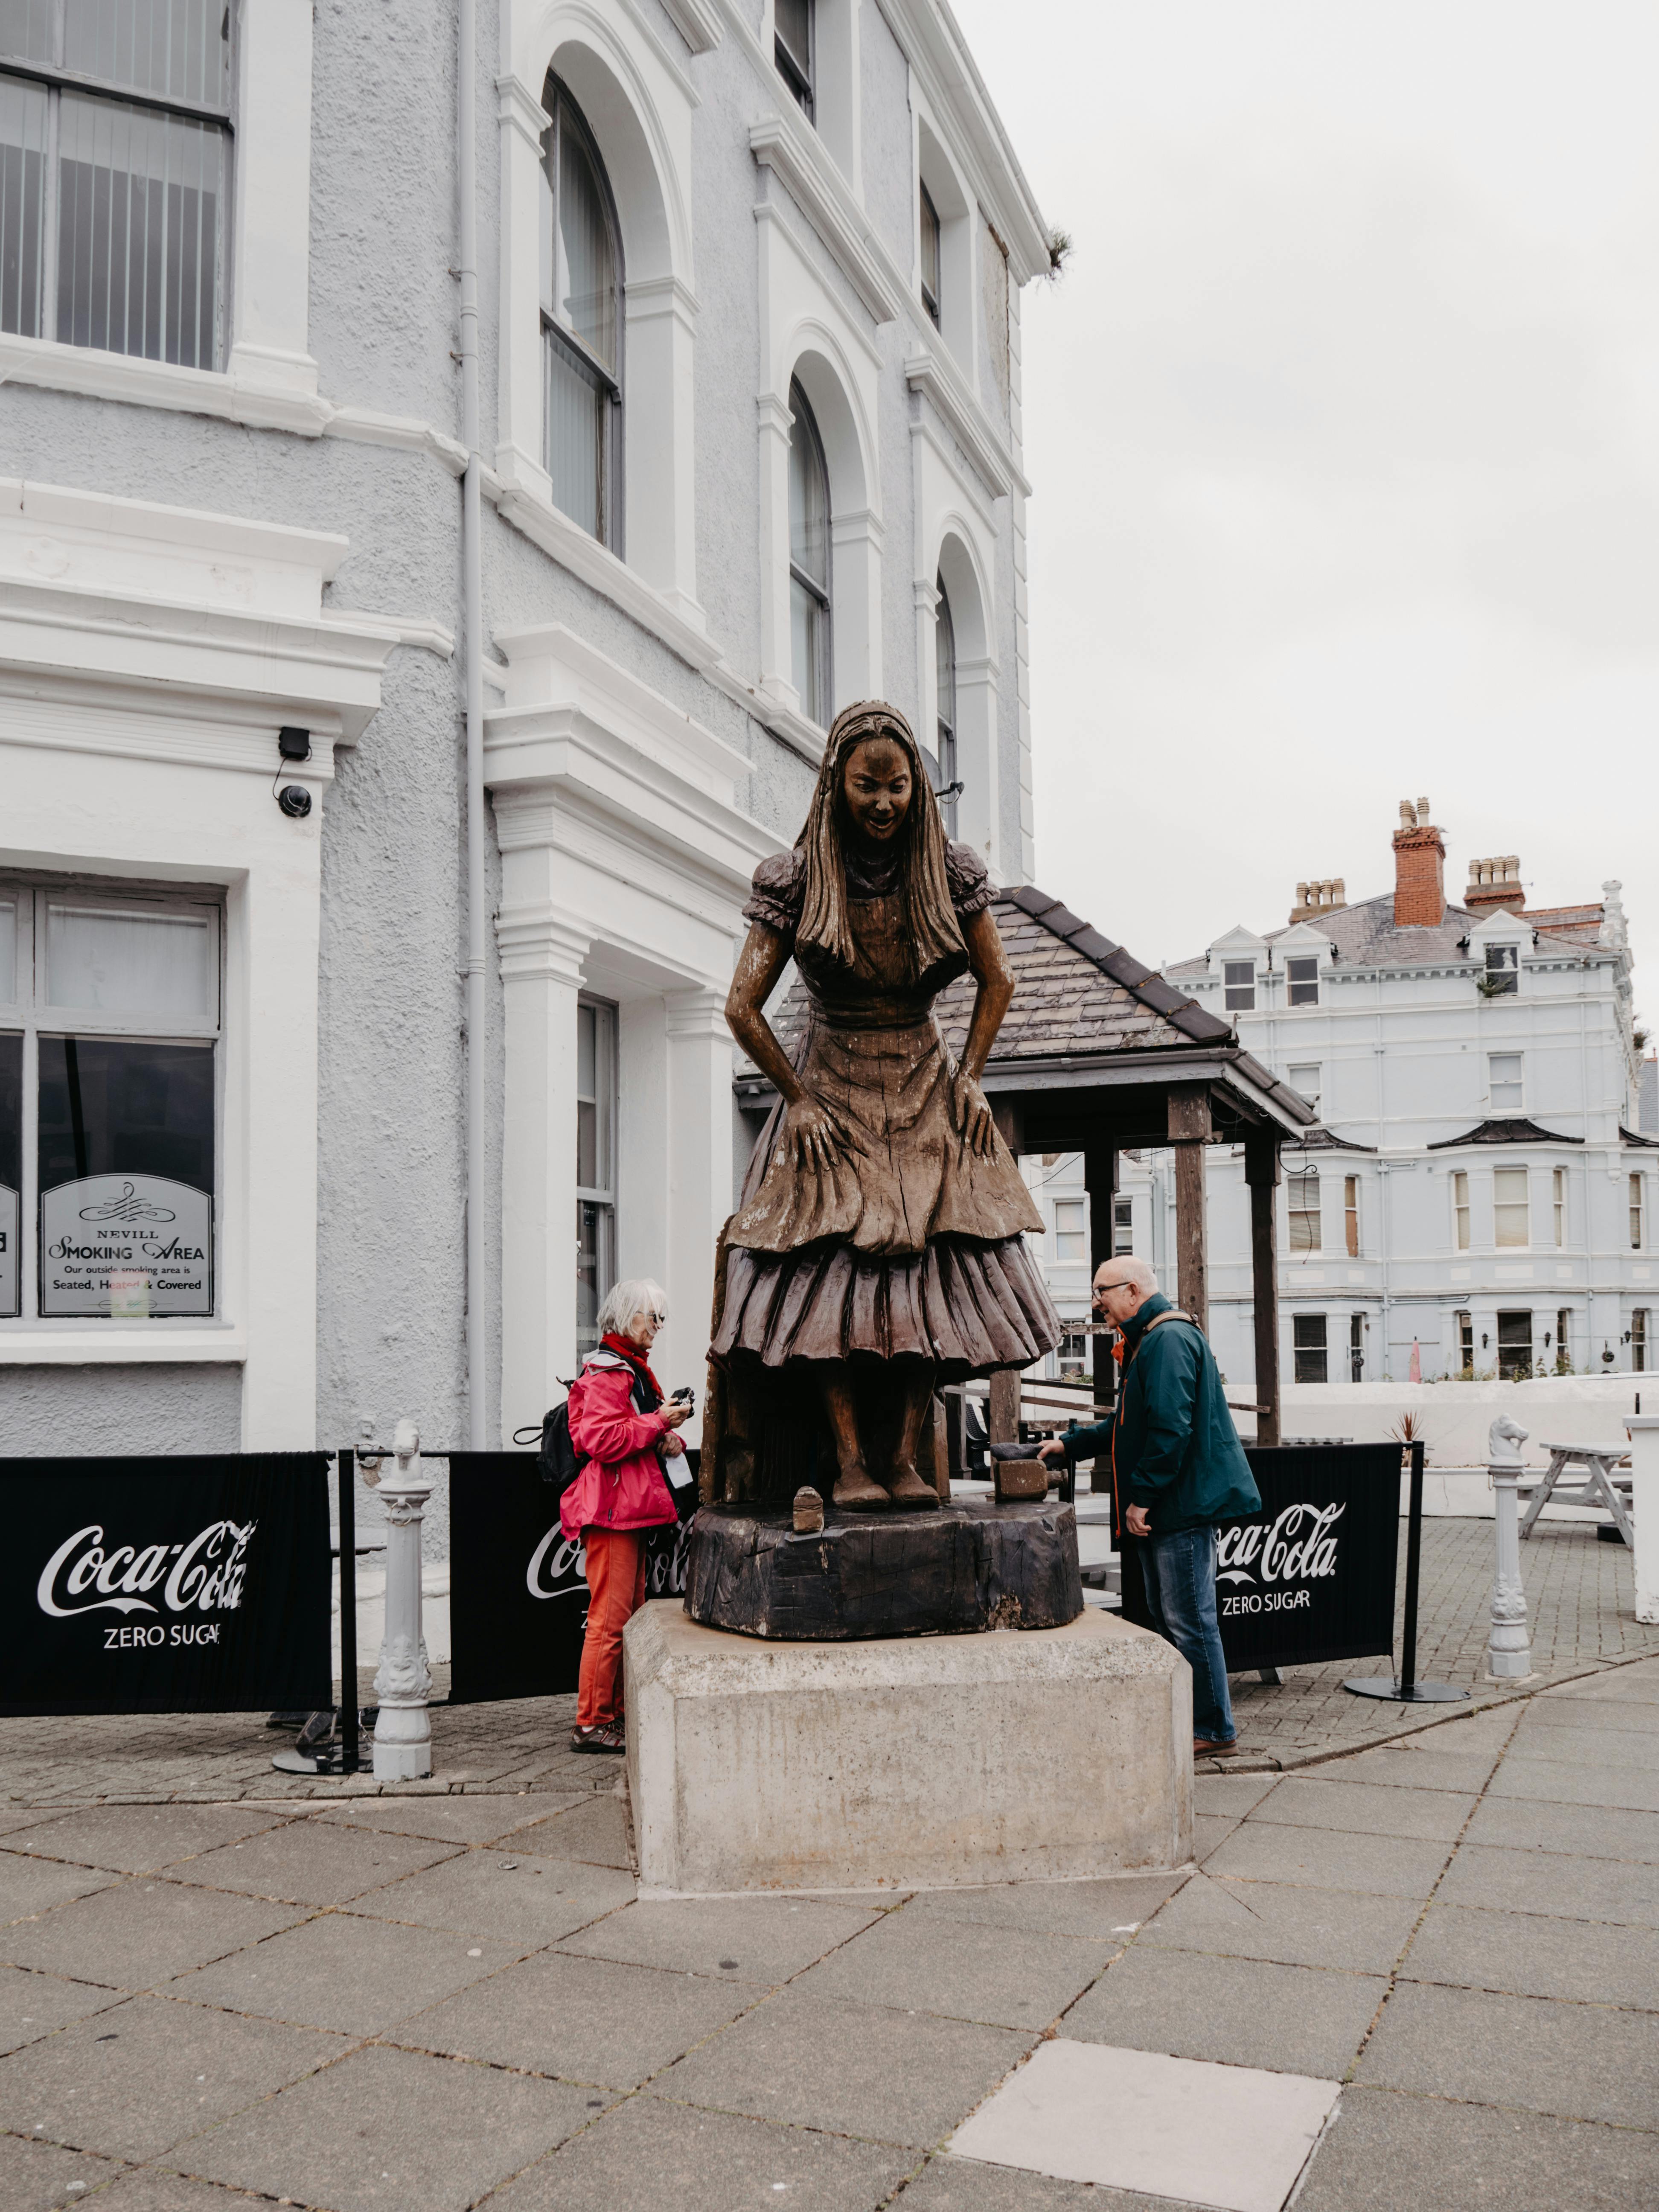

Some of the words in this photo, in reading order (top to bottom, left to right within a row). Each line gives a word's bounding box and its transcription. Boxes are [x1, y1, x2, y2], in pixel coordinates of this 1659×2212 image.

[97, 1231, 158, 1239] NEVILL
[49, 1236, 132, 1259] SMOKING
[142, 1237, 204, 1259] AREA
[122, 1266, 158, 1275] smoking
[53, 1280, 94, 1291] Seated,
[144, 1280, 153, 1289] &
[157, 1280, 201, 1289] Covered
[1222, 1595, 1262, 1615] ZERO
[1264, 1590, 1310, 1611] SUGAR
[104, 1626, 165, 1649] ZERO
